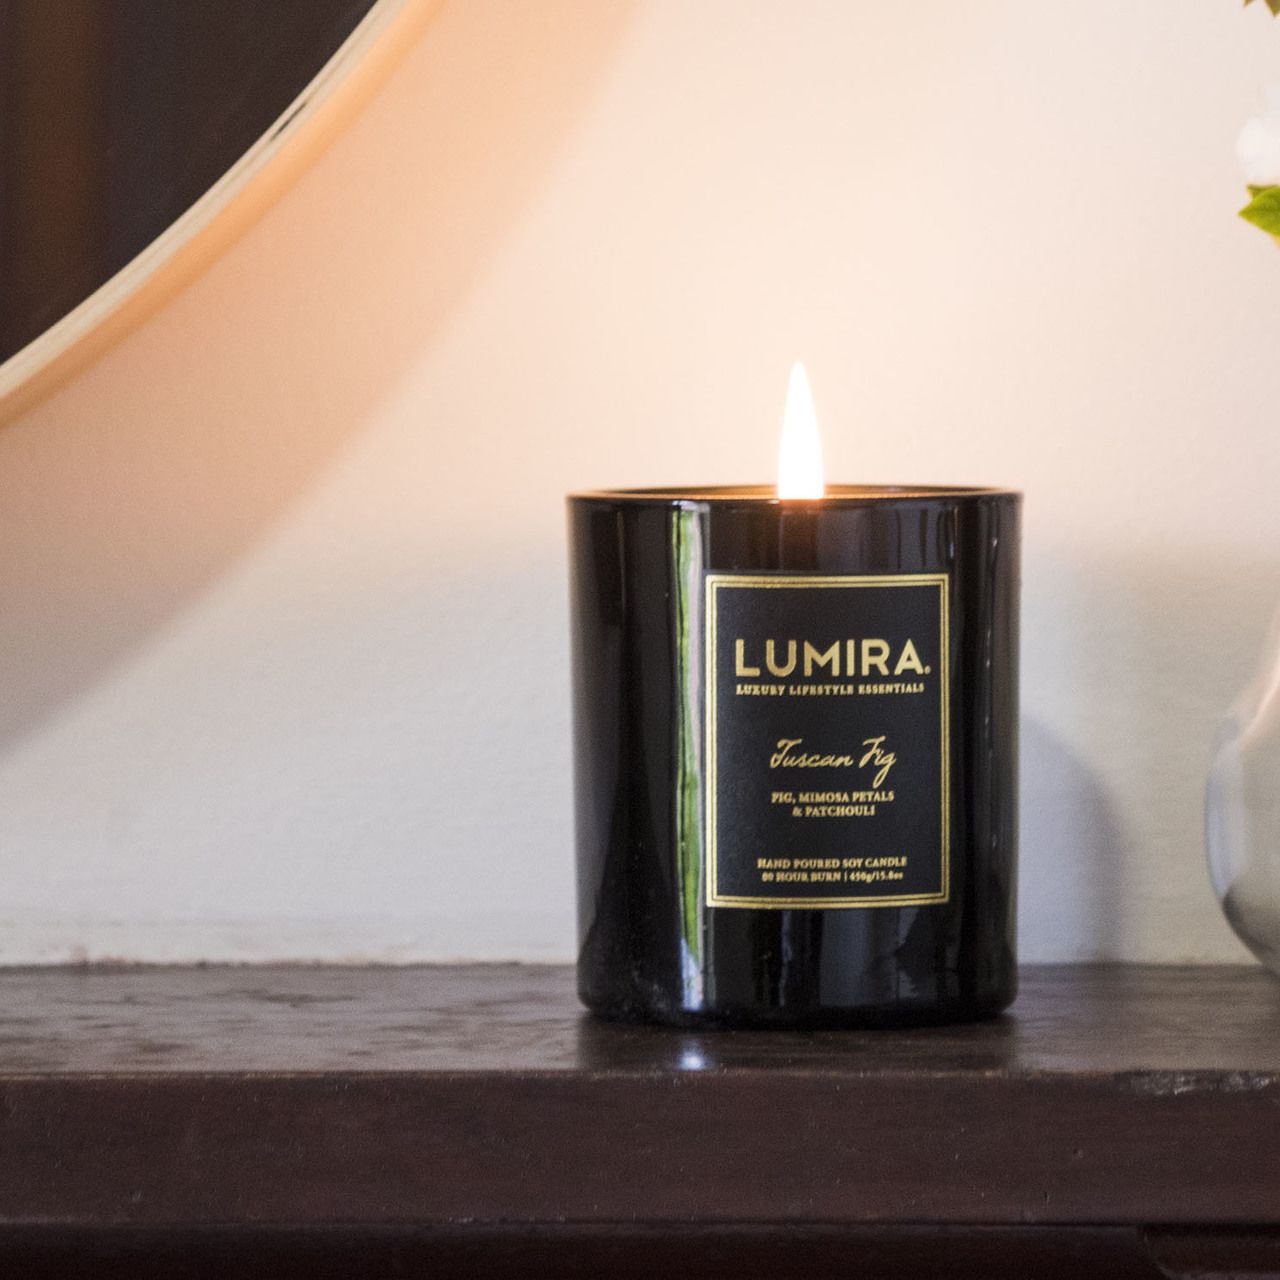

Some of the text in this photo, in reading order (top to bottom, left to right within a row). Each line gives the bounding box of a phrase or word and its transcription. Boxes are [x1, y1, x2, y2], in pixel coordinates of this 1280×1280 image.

[735, 638, 924, 678] LUMIRA
[736, 682, 925, 696] LUXURY LIFESTYLE ESSENTIALS
[770, 735, 897, 789] Tuscan Fig
[771, 790, 895, 804] FIG, MIMOSA PETALS
[792, 805, 876, 817] & PATCHOULI
[757, 856, 908, 869] HAND POURED SOY CANDLE
[776, 871, 808, 882] HOUR
[810, 871, 842, 882] BURN
